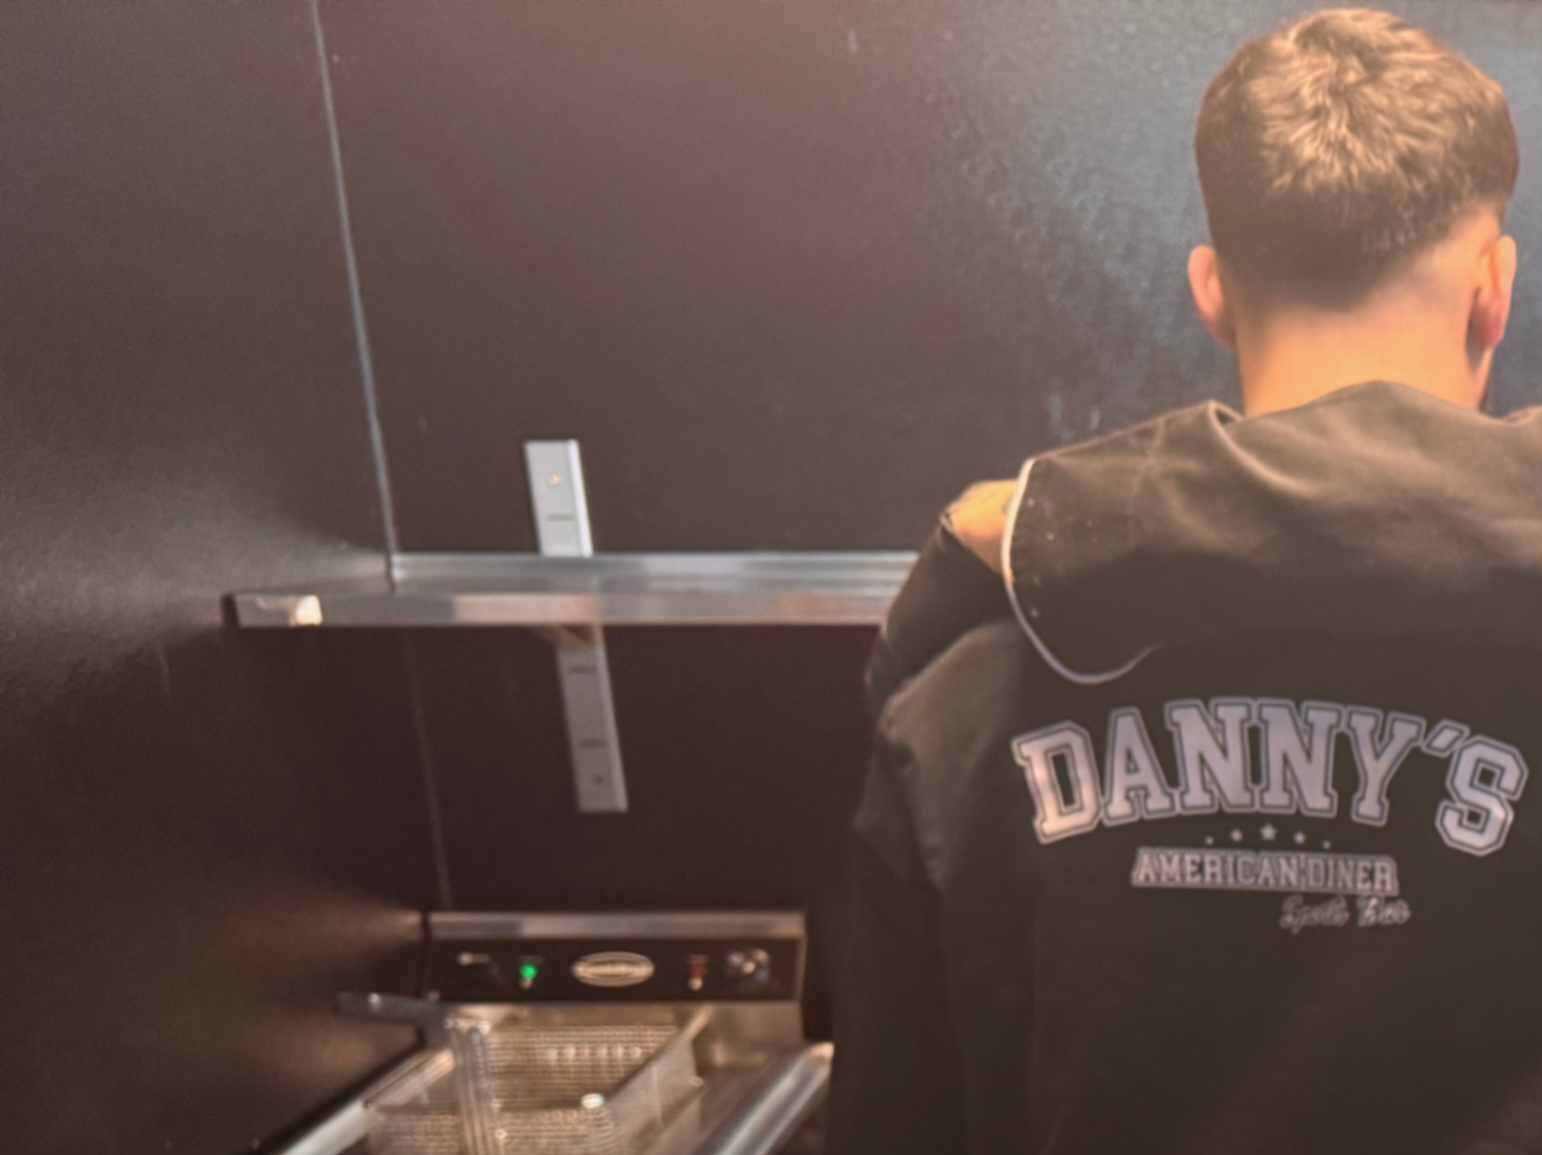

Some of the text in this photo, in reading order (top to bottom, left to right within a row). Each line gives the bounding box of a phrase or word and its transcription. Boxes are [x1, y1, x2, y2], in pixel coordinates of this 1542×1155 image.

[1011, 696, 1530, 857] DANNY'S
[1134, 848, 1398, 894] AMERICAN DINER
